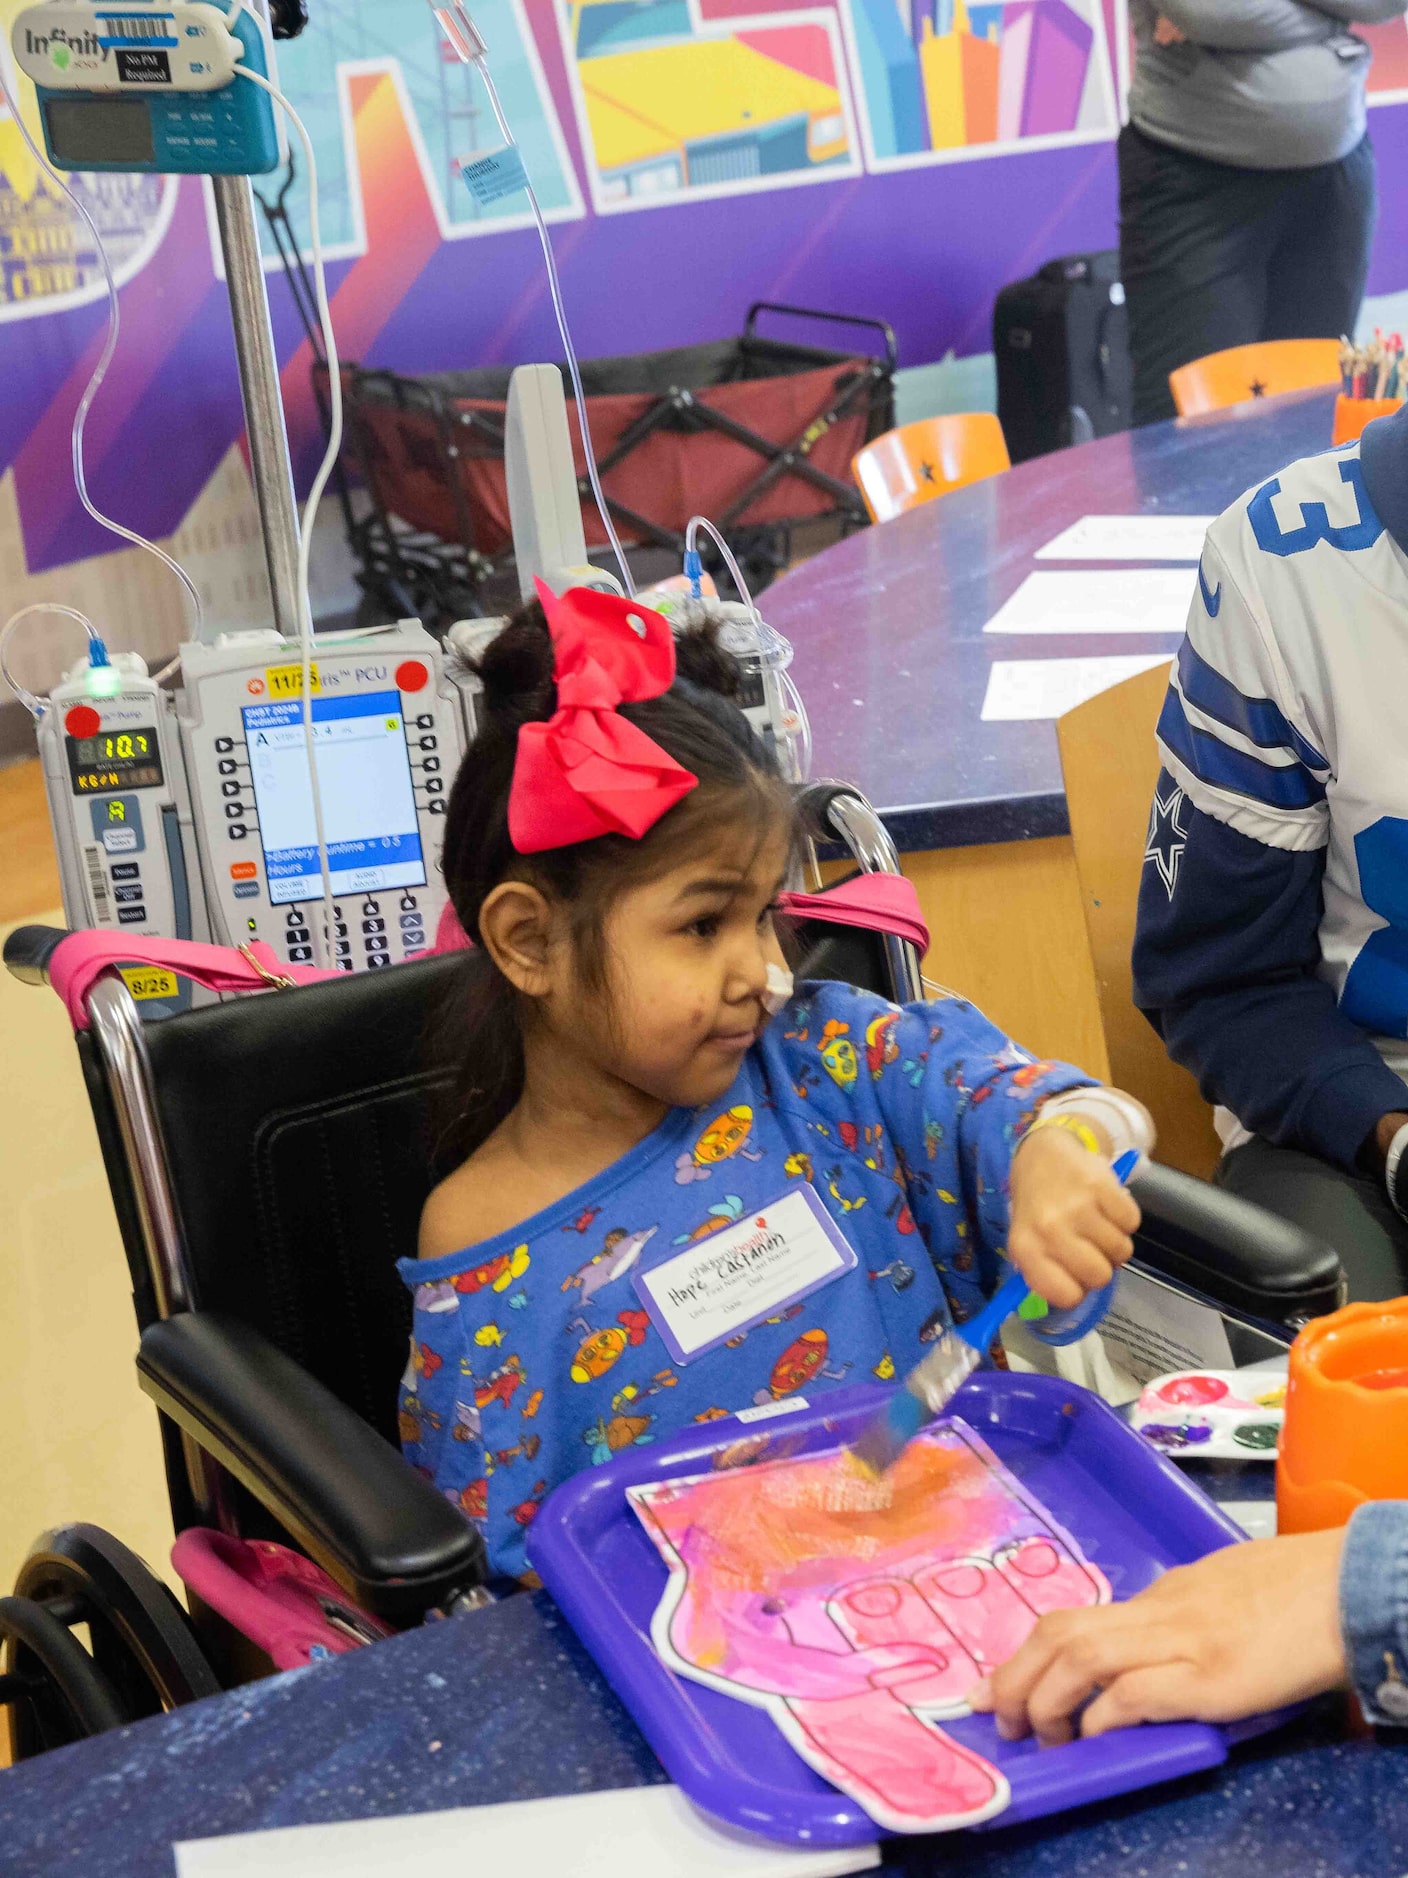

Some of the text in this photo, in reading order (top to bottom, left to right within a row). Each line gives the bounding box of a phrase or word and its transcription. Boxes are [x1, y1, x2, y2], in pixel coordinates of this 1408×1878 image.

[126, 54, 140, 64] No
[125, 69, 168, 82] Required
[355, 666, 388, 683] PCU
[255, 732, 269, 748] A
[132, 978, 170, 996] 8/25
[667, 1279, 709, 1308] Hope
